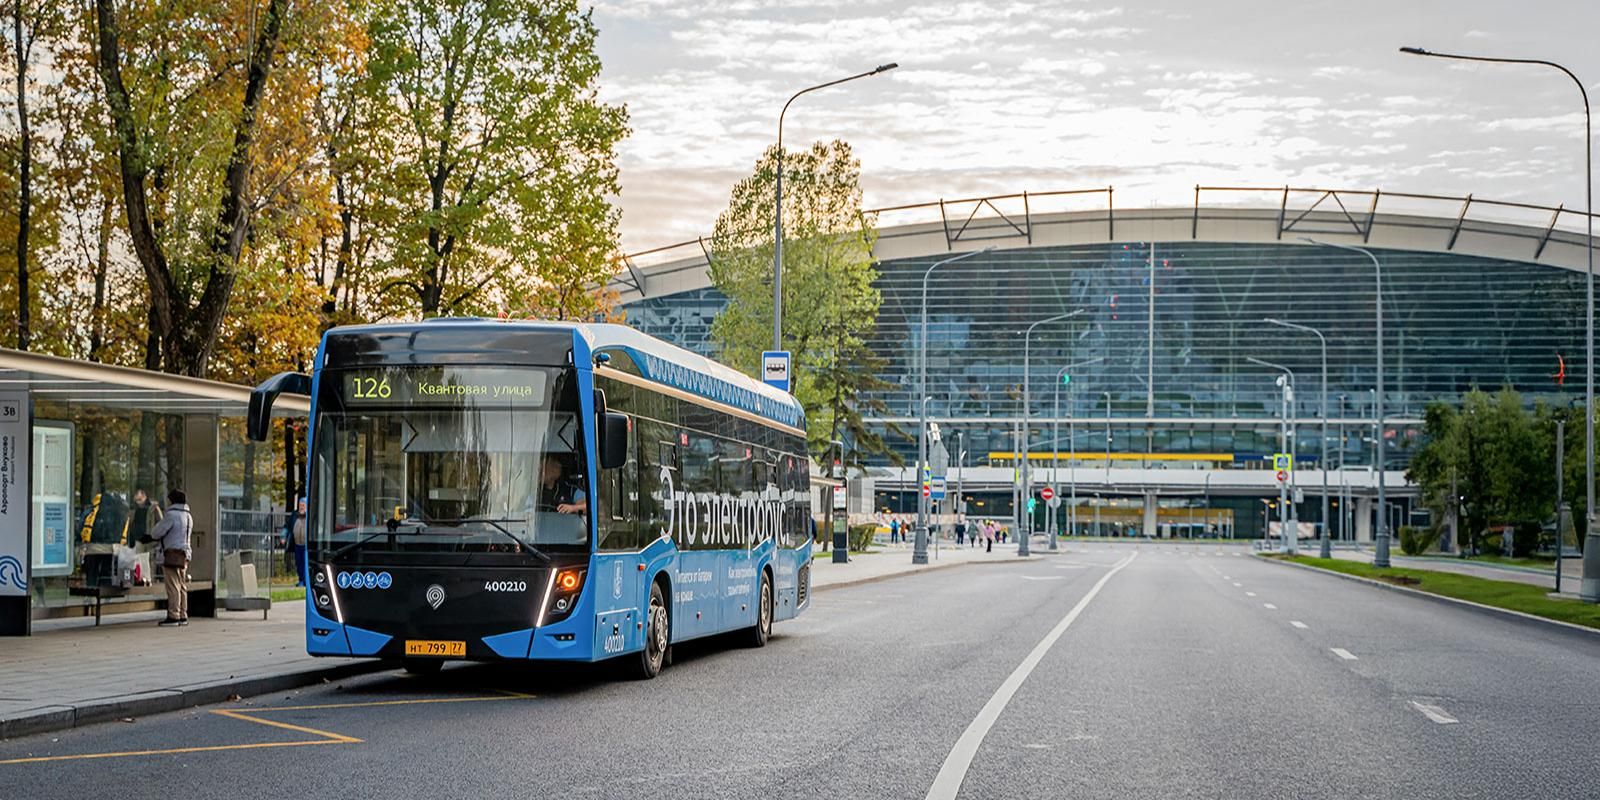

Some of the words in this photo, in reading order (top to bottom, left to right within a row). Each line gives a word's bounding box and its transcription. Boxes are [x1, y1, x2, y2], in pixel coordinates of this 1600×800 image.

[353, 377, 392, 398] 126
[418, 382, 487, 395] Квантовая
[493, 385, 532, 397] улица
[659, 466, 697, 545] Это
[484, 581, 527, 592] 400210
[427, 643, 446, 653] 799
[453, 643, 462, 651] 77
[604, 634, 624, 654] 400210
